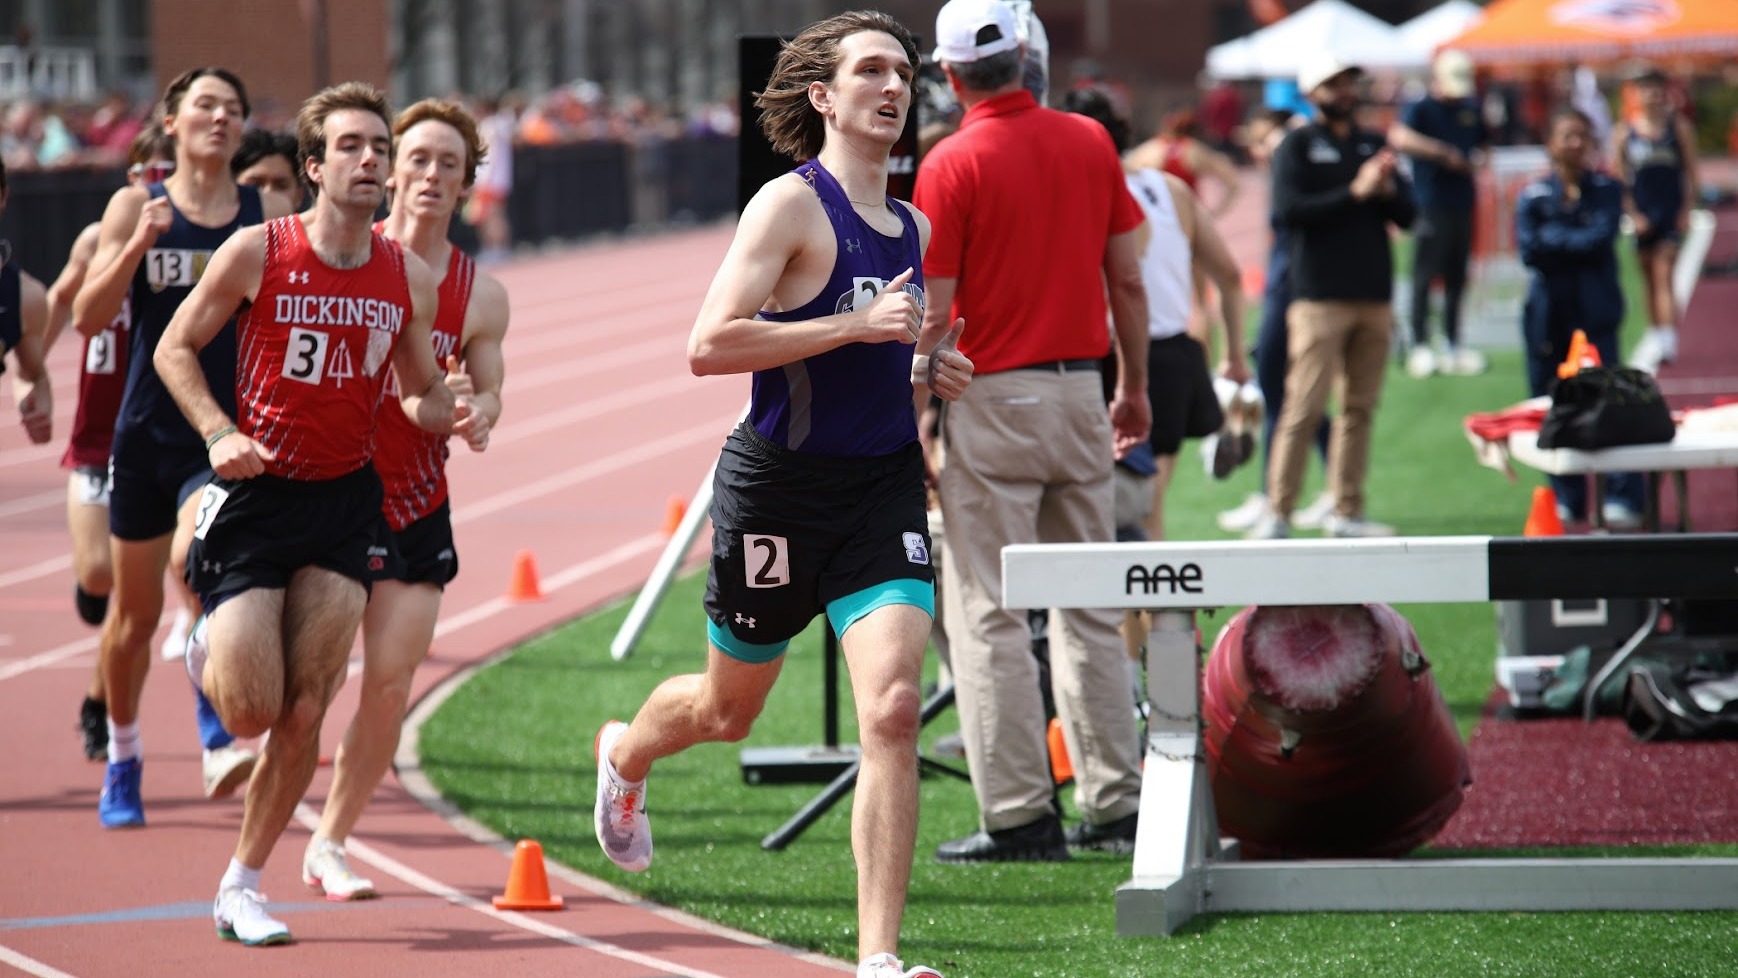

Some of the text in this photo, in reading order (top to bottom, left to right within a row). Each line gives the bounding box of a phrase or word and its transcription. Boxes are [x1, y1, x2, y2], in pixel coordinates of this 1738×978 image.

[152, 253, 181, 281] 13
[274, 294, 404, 335] DICKINSON
[96, 335, 109, 369] 9
[290, 333, 318, 378] 3
[195, 489, 218, 531] 3
[753, 537, 781, 585] 2
[902, 532, 930, 565] S
